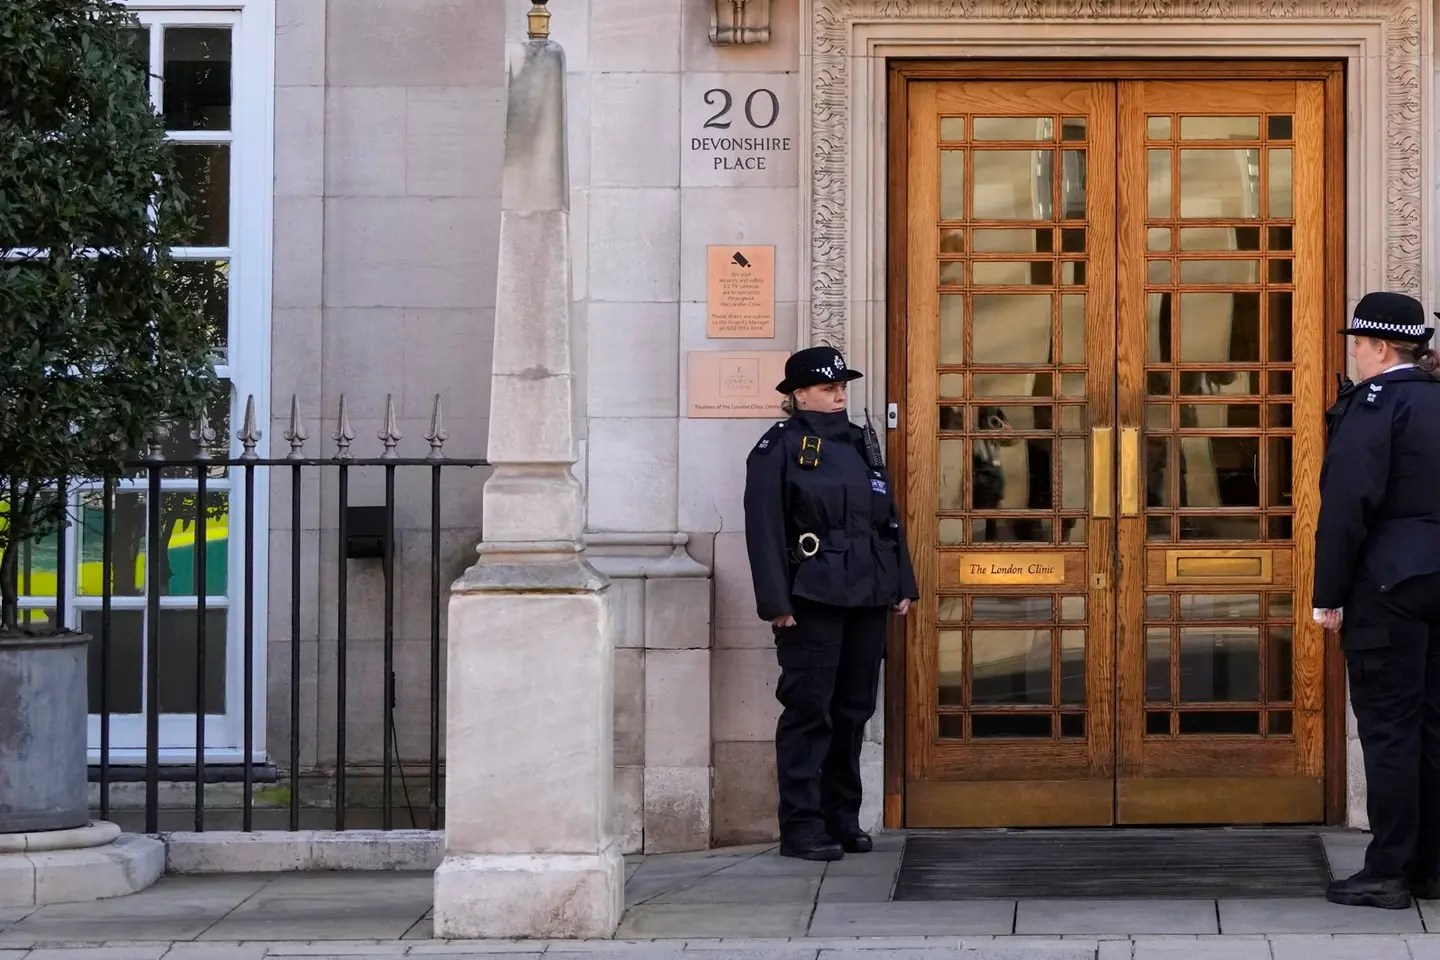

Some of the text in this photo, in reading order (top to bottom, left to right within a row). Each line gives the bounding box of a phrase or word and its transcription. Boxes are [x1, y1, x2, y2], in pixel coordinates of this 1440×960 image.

[702, 88, 780, 130] 20
[691, 137, 791, 151] DEVONSHIRE
[713, 157, 766, 170] PLACE
[970, 564, 1055, 574] The London Clinic
